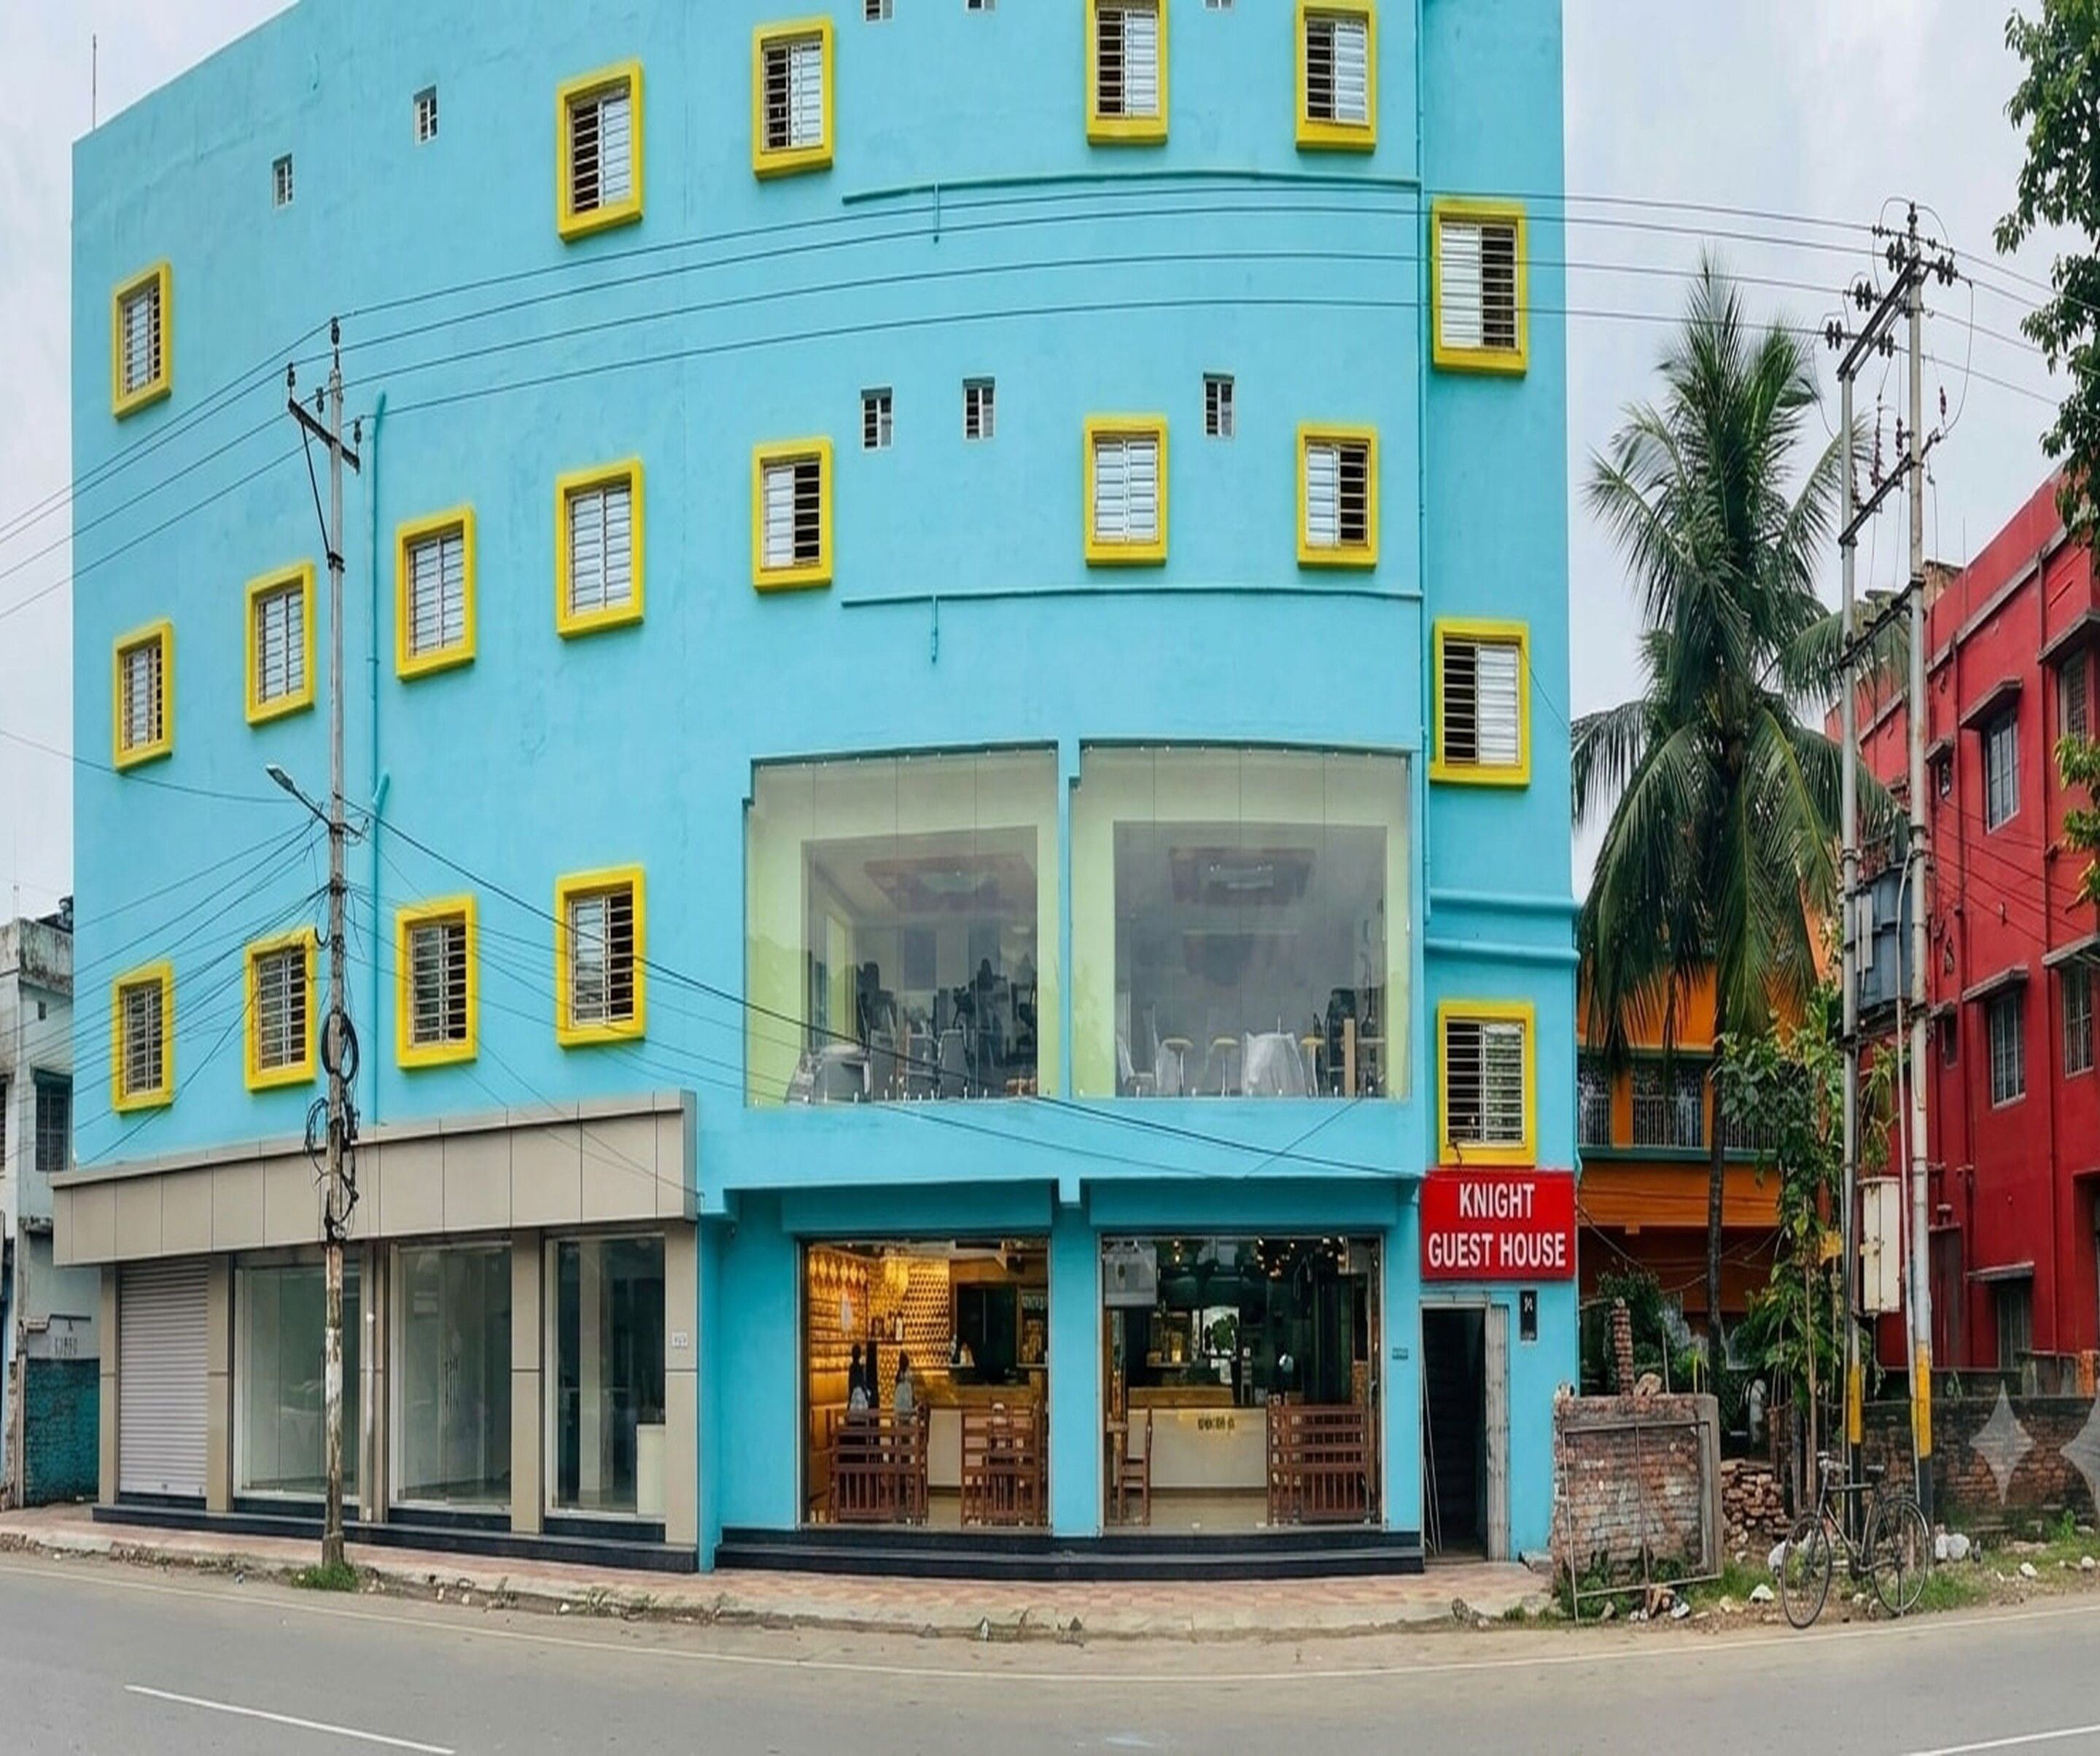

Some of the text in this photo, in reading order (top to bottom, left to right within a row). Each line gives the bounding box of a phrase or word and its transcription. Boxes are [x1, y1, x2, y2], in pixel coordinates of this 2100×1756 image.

[1459, 1183, 1536, 1219] KNIGHT
[1428, 1232, 1566, 1267] GUEST HOUSE
